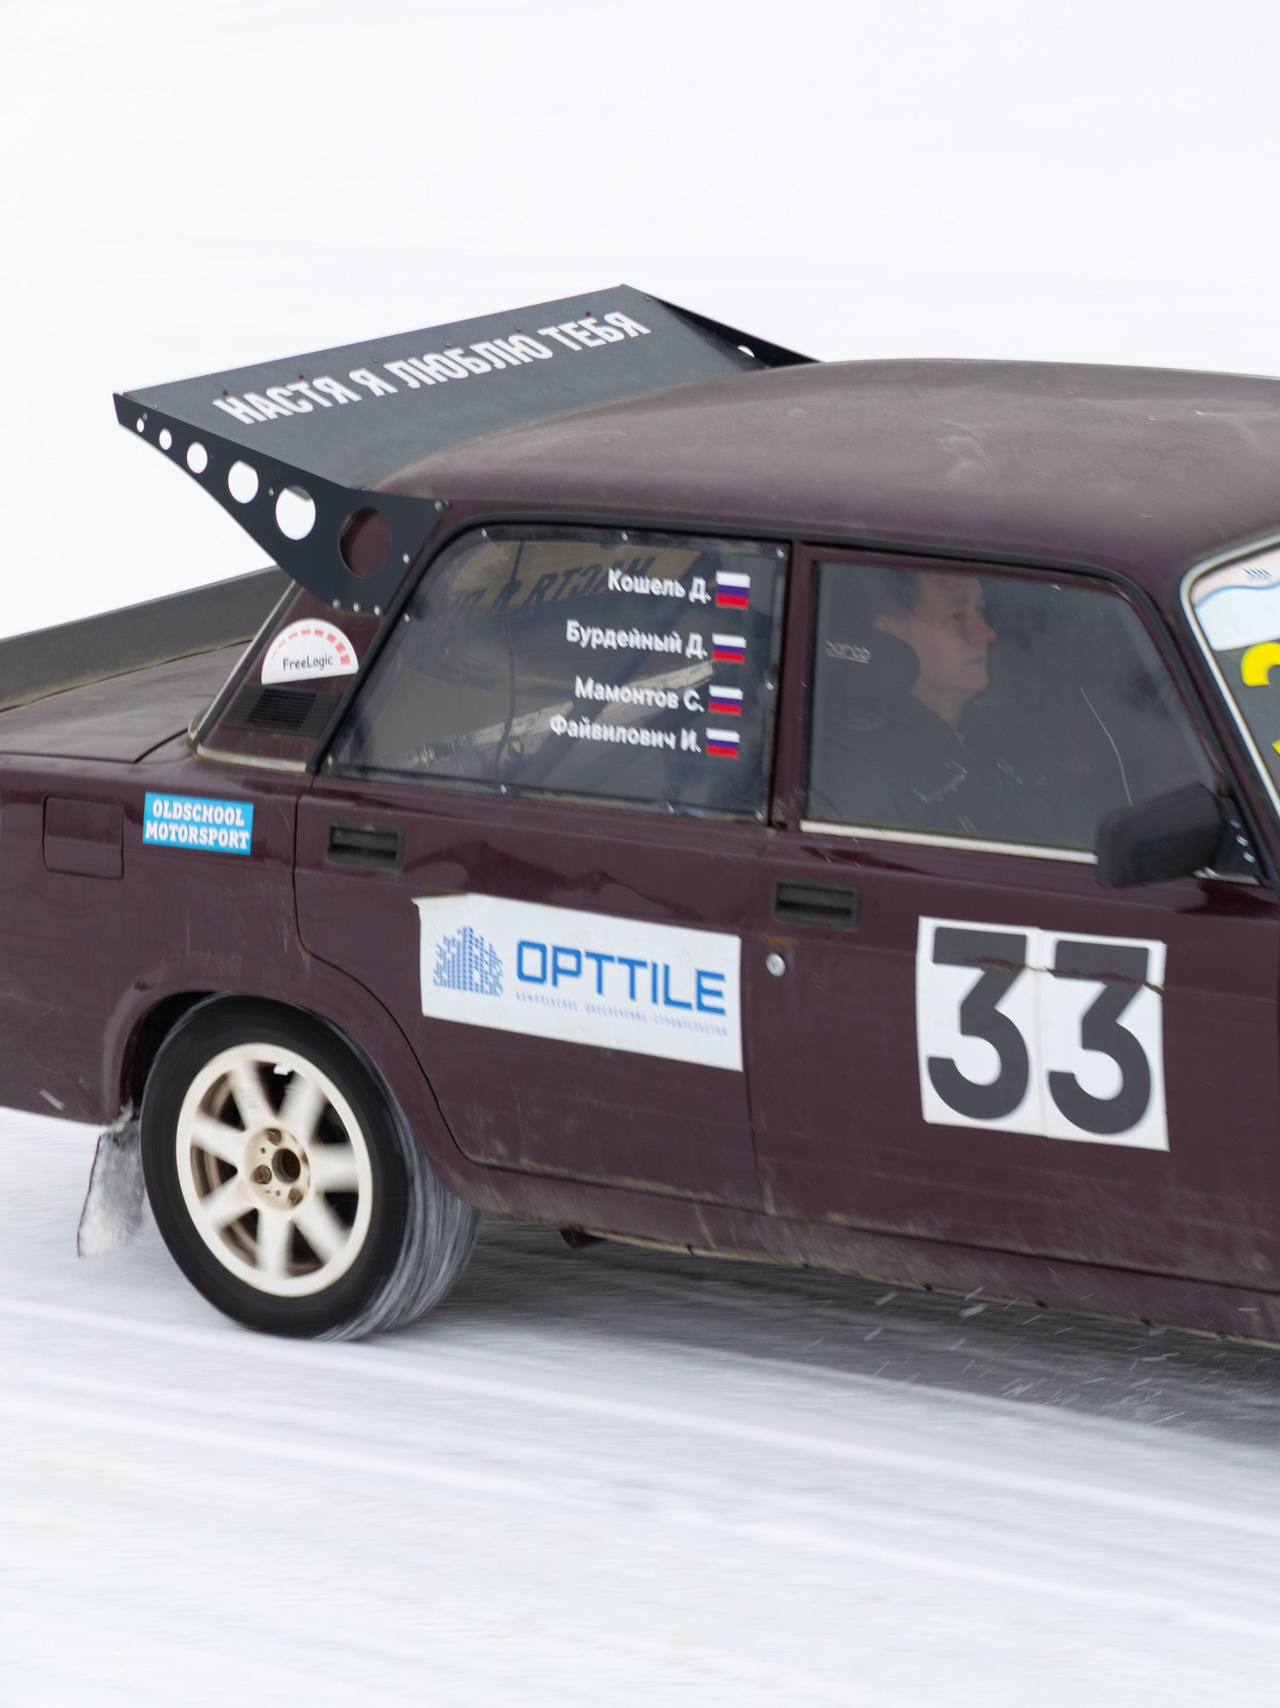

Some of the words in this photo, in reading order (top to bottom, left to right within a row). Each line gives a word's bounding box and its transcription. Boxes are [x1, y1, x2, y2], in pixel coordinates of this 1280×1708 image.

[212, 375, 362, 424] НАСТЯ
[349, 367, 399, 397] Я
[383, 334, 553, 389] ЛЮБЛЮ
[537, 311, 651, 351] ТЕБЯ
[607, 567, 686, 598] Кошель
[688, 576, 712, 604] Д.
[566, 618, 683, 654] Бурдейный
[685, 632, 708, 660] Д.
[282, 655, 334, 671] FreeLogic
[574, 675, 680, 710] Мамонтов
[683, 688, 705, 713] С.
[550, 713, 677, 751] Файвилович
[680, 727, 702, 753] И.
[152, 798, 245, 827] OLDSCHOOL
[145, 821, 250, 850] MOTORSPORT
[517, 938, 727, 1016] OPTTILE
[927, 926, 1152, 1135] 33
